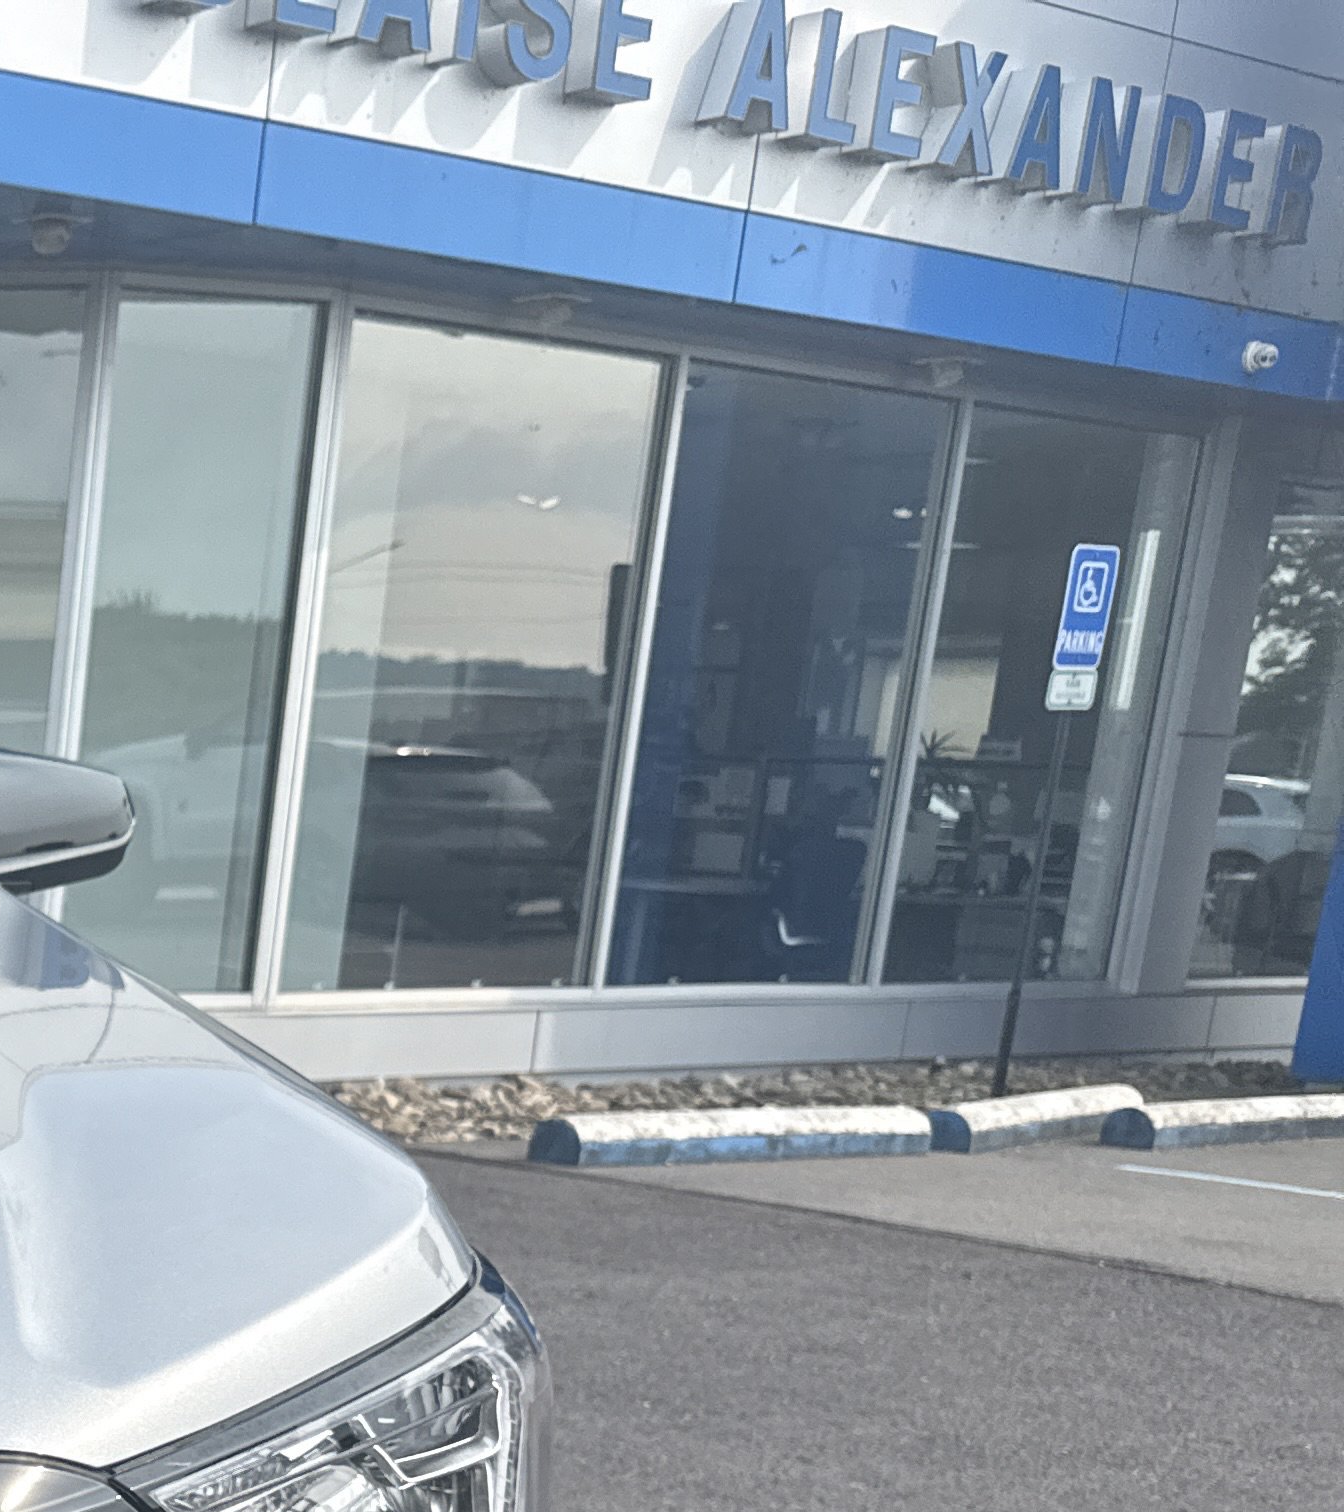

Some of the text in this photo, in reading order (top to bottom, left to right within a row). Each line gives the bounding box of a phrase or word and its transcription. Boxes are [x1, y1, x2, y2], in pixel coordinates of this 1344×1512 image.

[202, 0, 1324, 246] ISE ALEXANDER
[1058, 629, 1103, 654] PARKING
